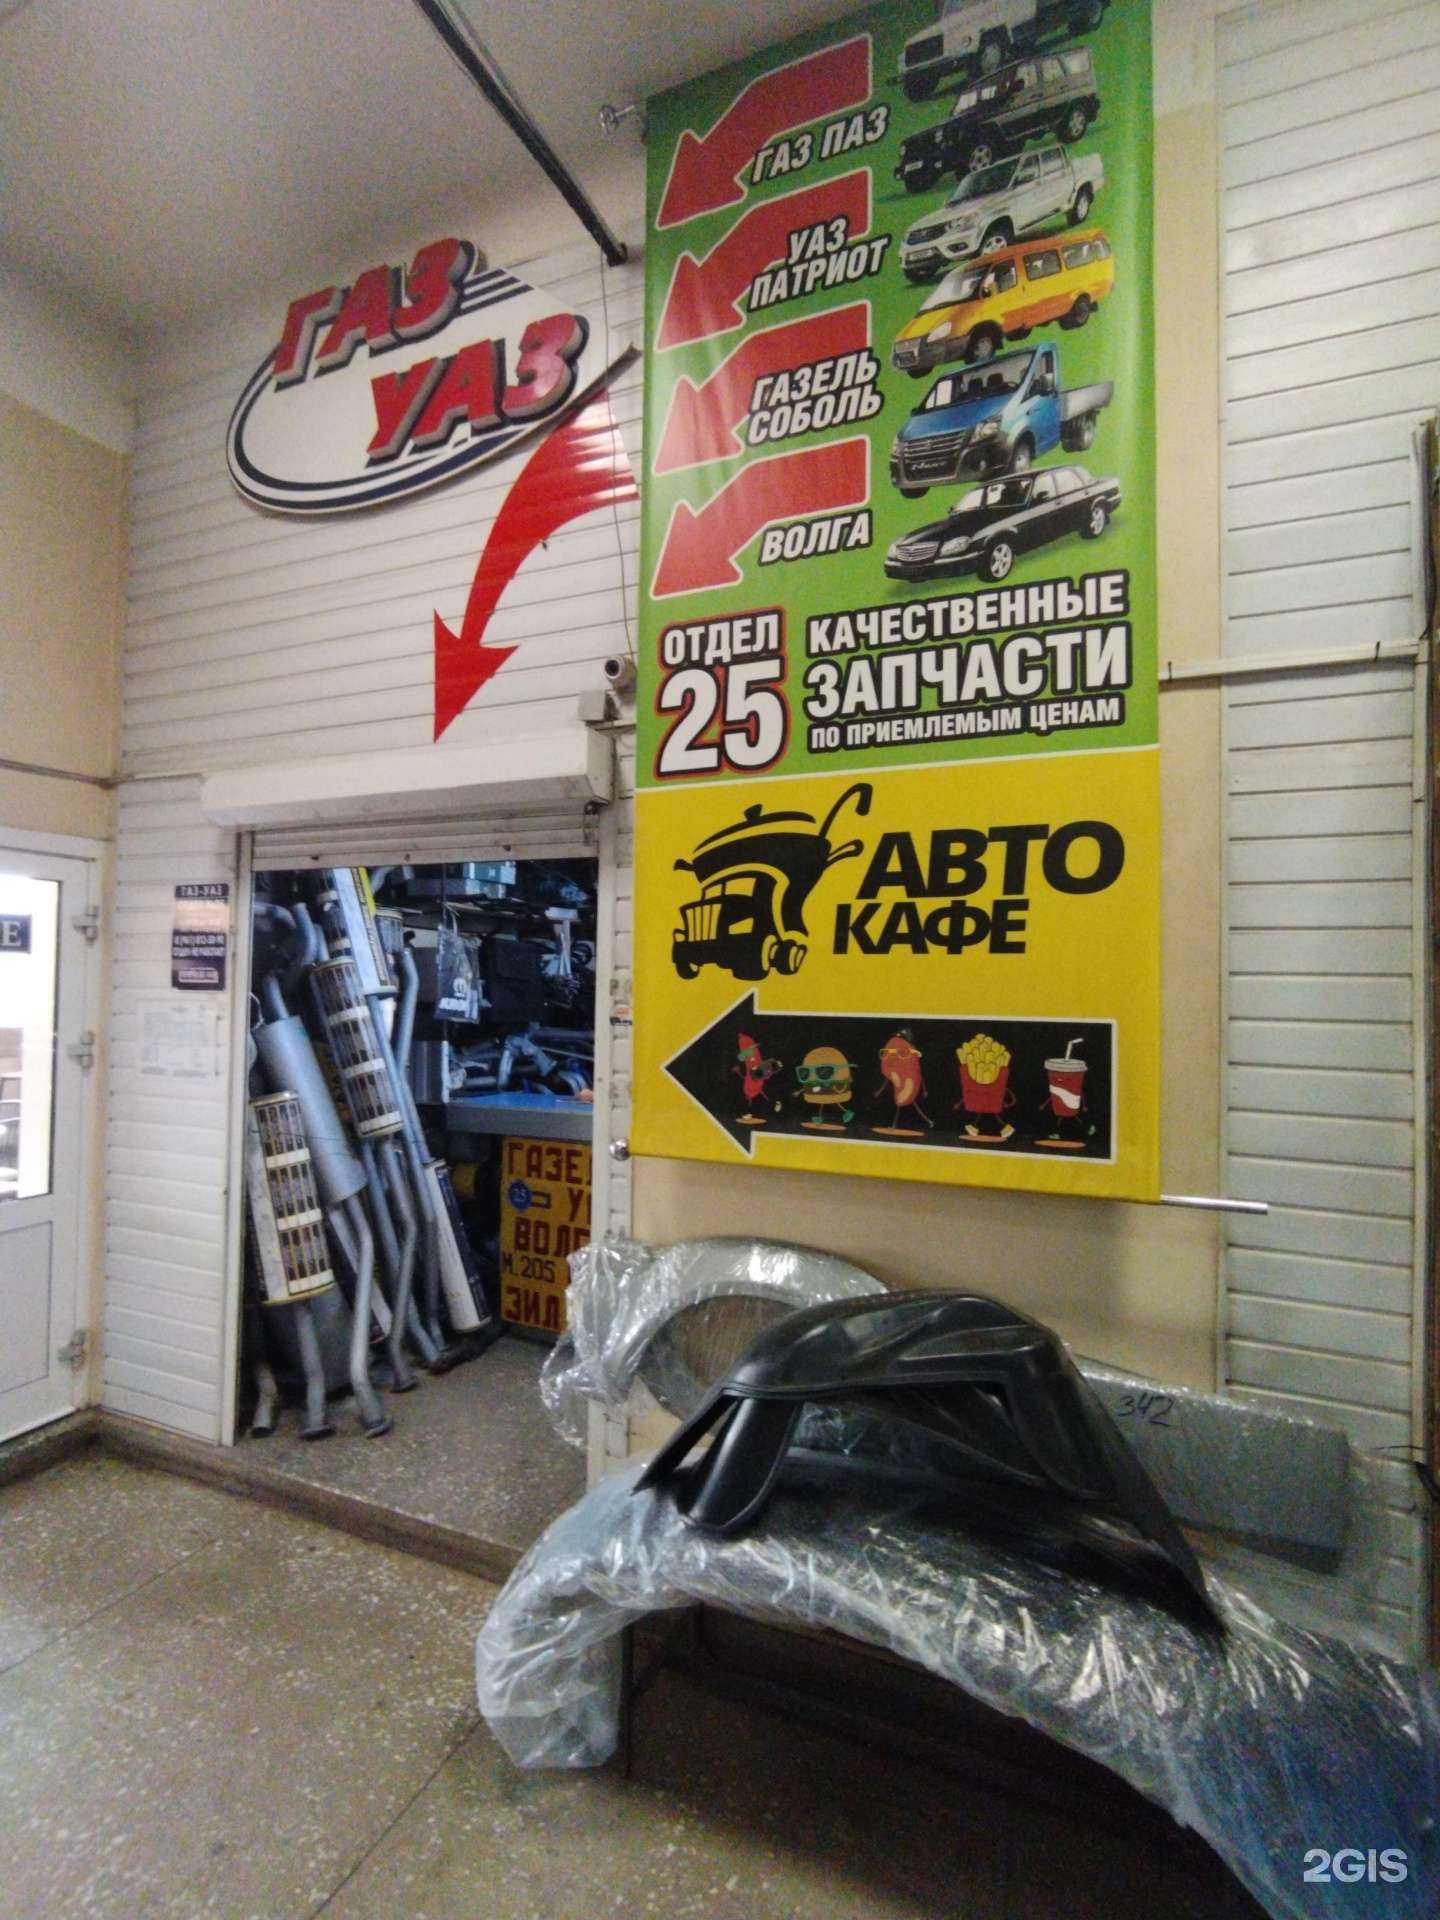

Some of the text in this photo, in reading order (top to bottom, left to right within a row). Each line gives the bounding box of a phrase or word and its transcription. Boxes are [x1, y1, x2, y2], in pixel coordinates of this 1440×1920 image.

[752, 106, 890, 184] ГАЗ ПАЗ
[787, 217, 848, 265] УАЗ
[750, 236, 890, 310] ПАТРИОТ
[272, 237, 477, 391] ГАЗ
[366, 312, 590, 468] УАЗ
[752, 350, 878, 411] ГАЗЕЛЬ
[747, 384, 883, 444] СОБОЛЬ
[760, 512, 870, 564] ВОЛГА
[663, 613, 780, 667] ОТДЕЛ
[809, 574, 1126, 655] КАЧЕСТВЕННЫЕ
[804, 625, 1128, 718] ЗАПЧАСТИ
[659, 658, 785, 774] 25
[811, 698, 1120, 750] ПО ПРИЕМЛЕМЫМ ЦЕНАМ
[856, 819, 1126, 900] АВТО
[832, 898, 1030, 956] КАФЕ
[507, 1142, 592, 1186] ГАЗЕ
[505, 1285, 560, 1331] ЗИЛ
[1117, 1391, 1174, 1427] 342
